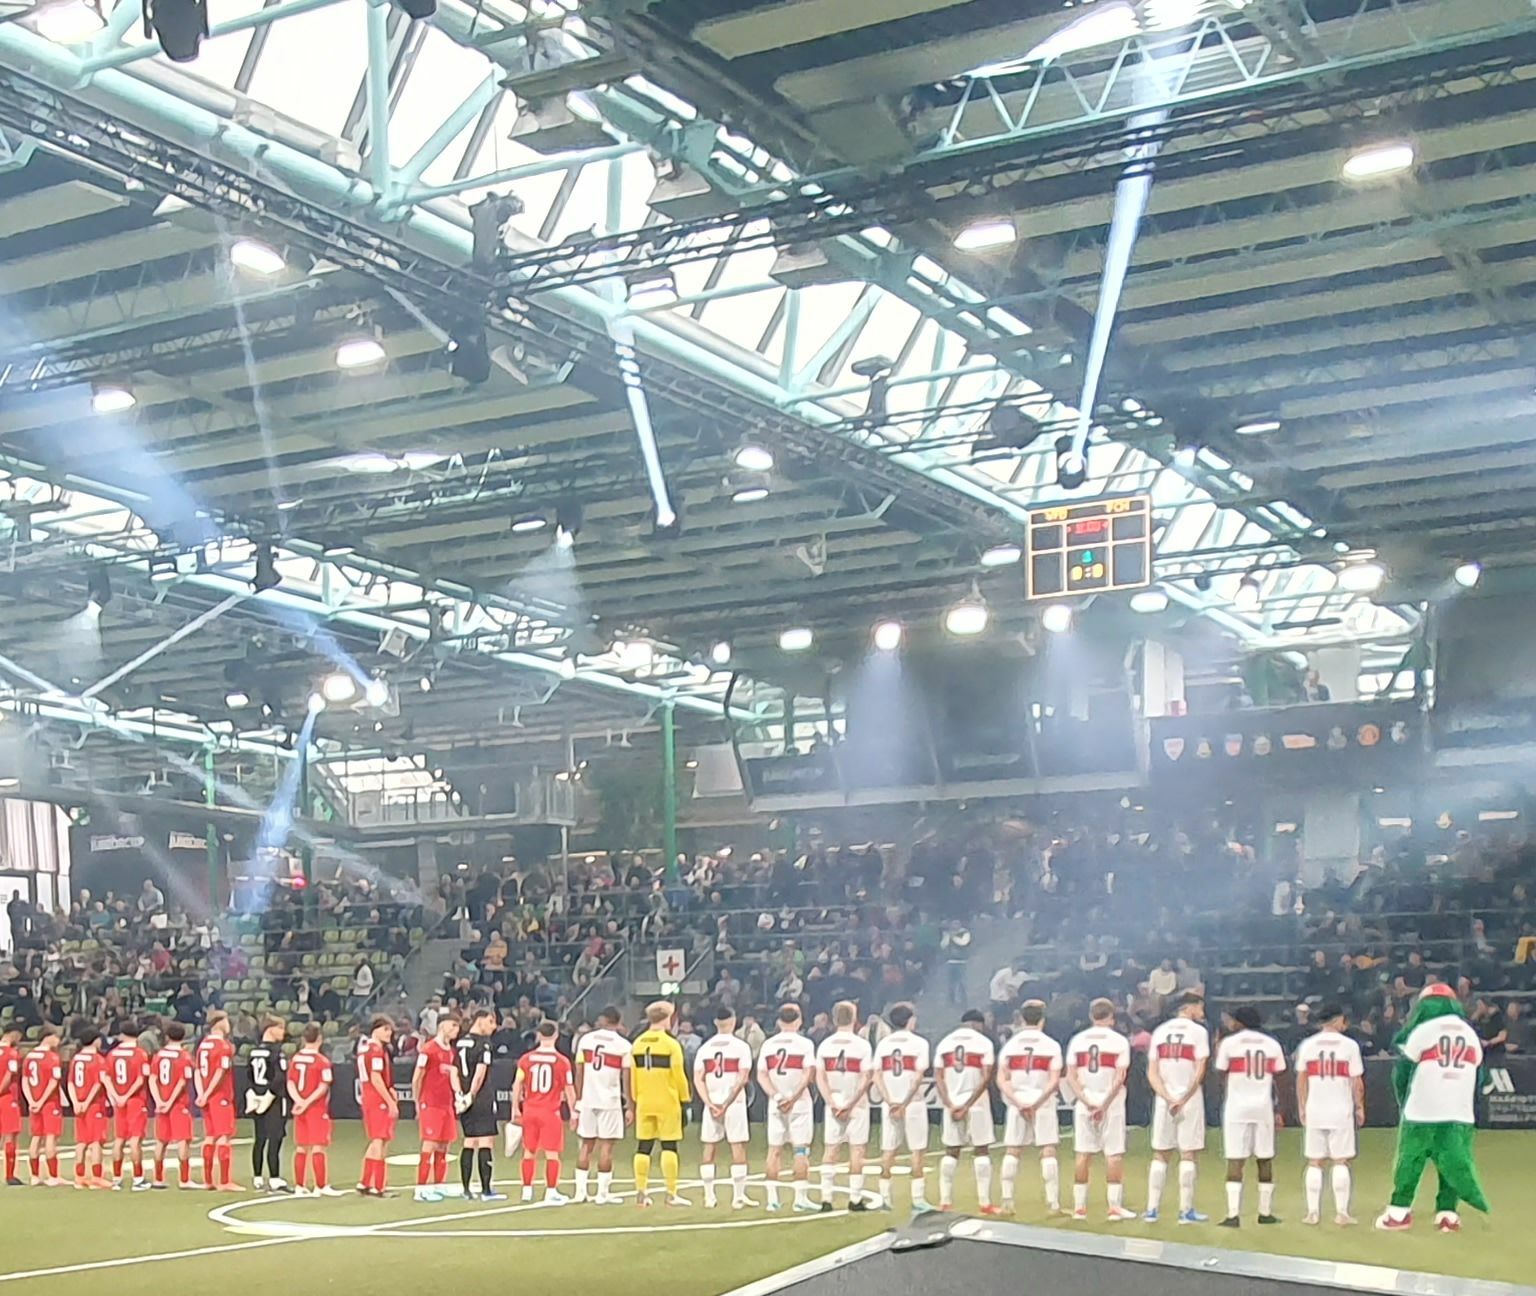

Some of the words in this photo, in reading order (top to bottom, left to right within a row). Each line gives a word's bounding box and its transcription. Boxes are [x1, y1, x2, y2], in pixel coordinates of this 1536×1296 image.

[592, 1044, 605, 1071] 5
[776, 1048, 787, 1076] 2
[1245, 1049, 1265, 1080] 10
[1319, 1050, 1336, 1081] 11
[1438, 1035, 1466, 1070] 92
[28, 1061, 39, 1087] 3
[115, 1058, 128, 1085] 9
[250, 1057, 269, 1085] 12
[530, 1063, 552, 1093] 10
